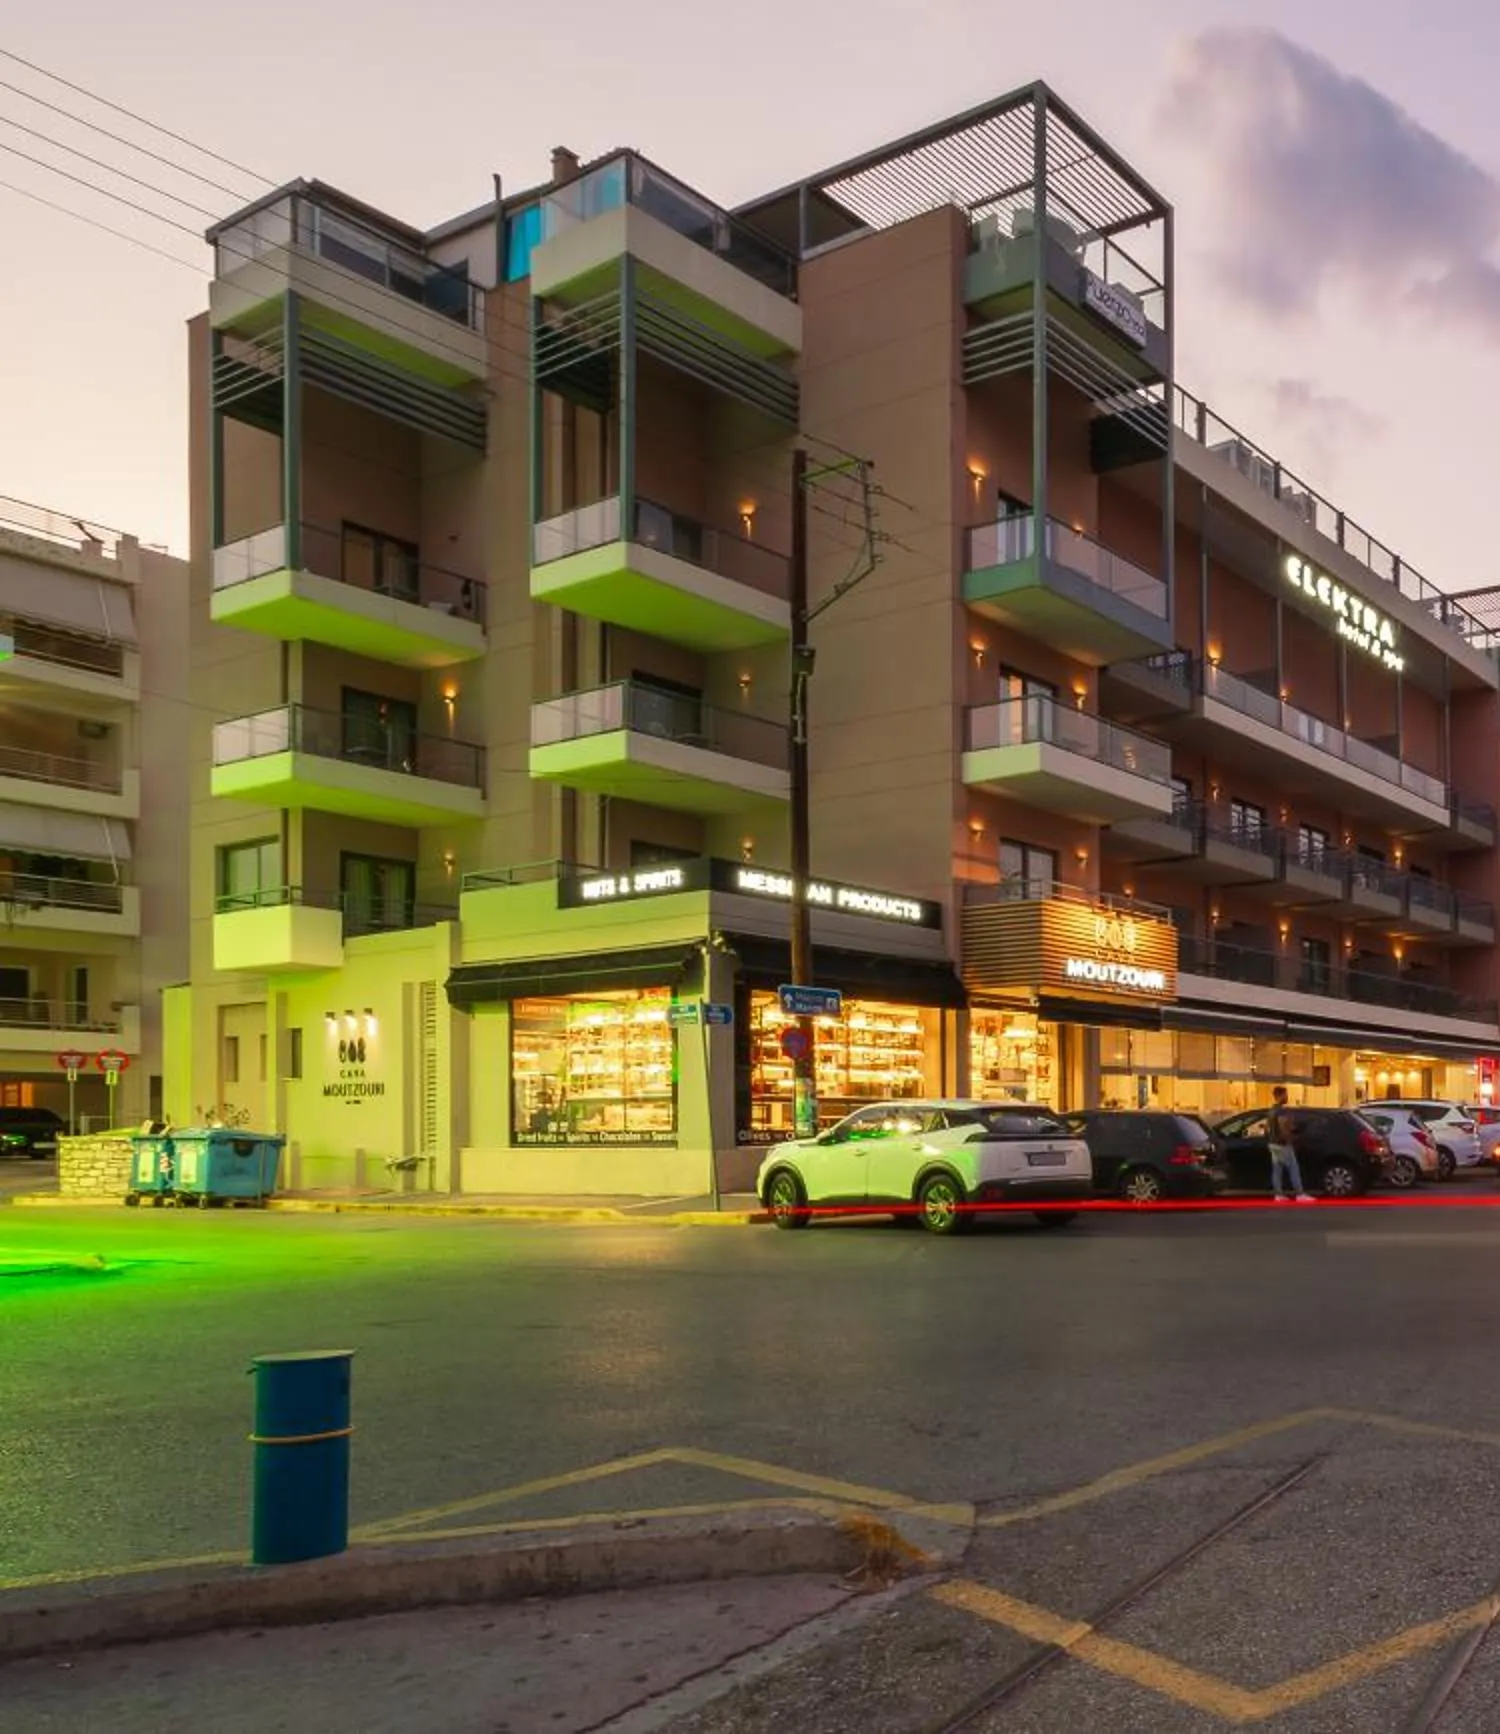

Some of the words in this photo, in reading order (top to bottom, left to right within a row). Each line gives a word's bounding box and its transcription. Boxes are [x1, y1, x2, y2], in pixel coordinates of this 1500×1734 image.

[1286, 556, 1395, 648] ELEKTRA
[634, 869, 681, 892] SPIRITS
[838, 888, 921, 920] PRODUCTS
[323, 1083, 385, 1097] MOUTZOURI
